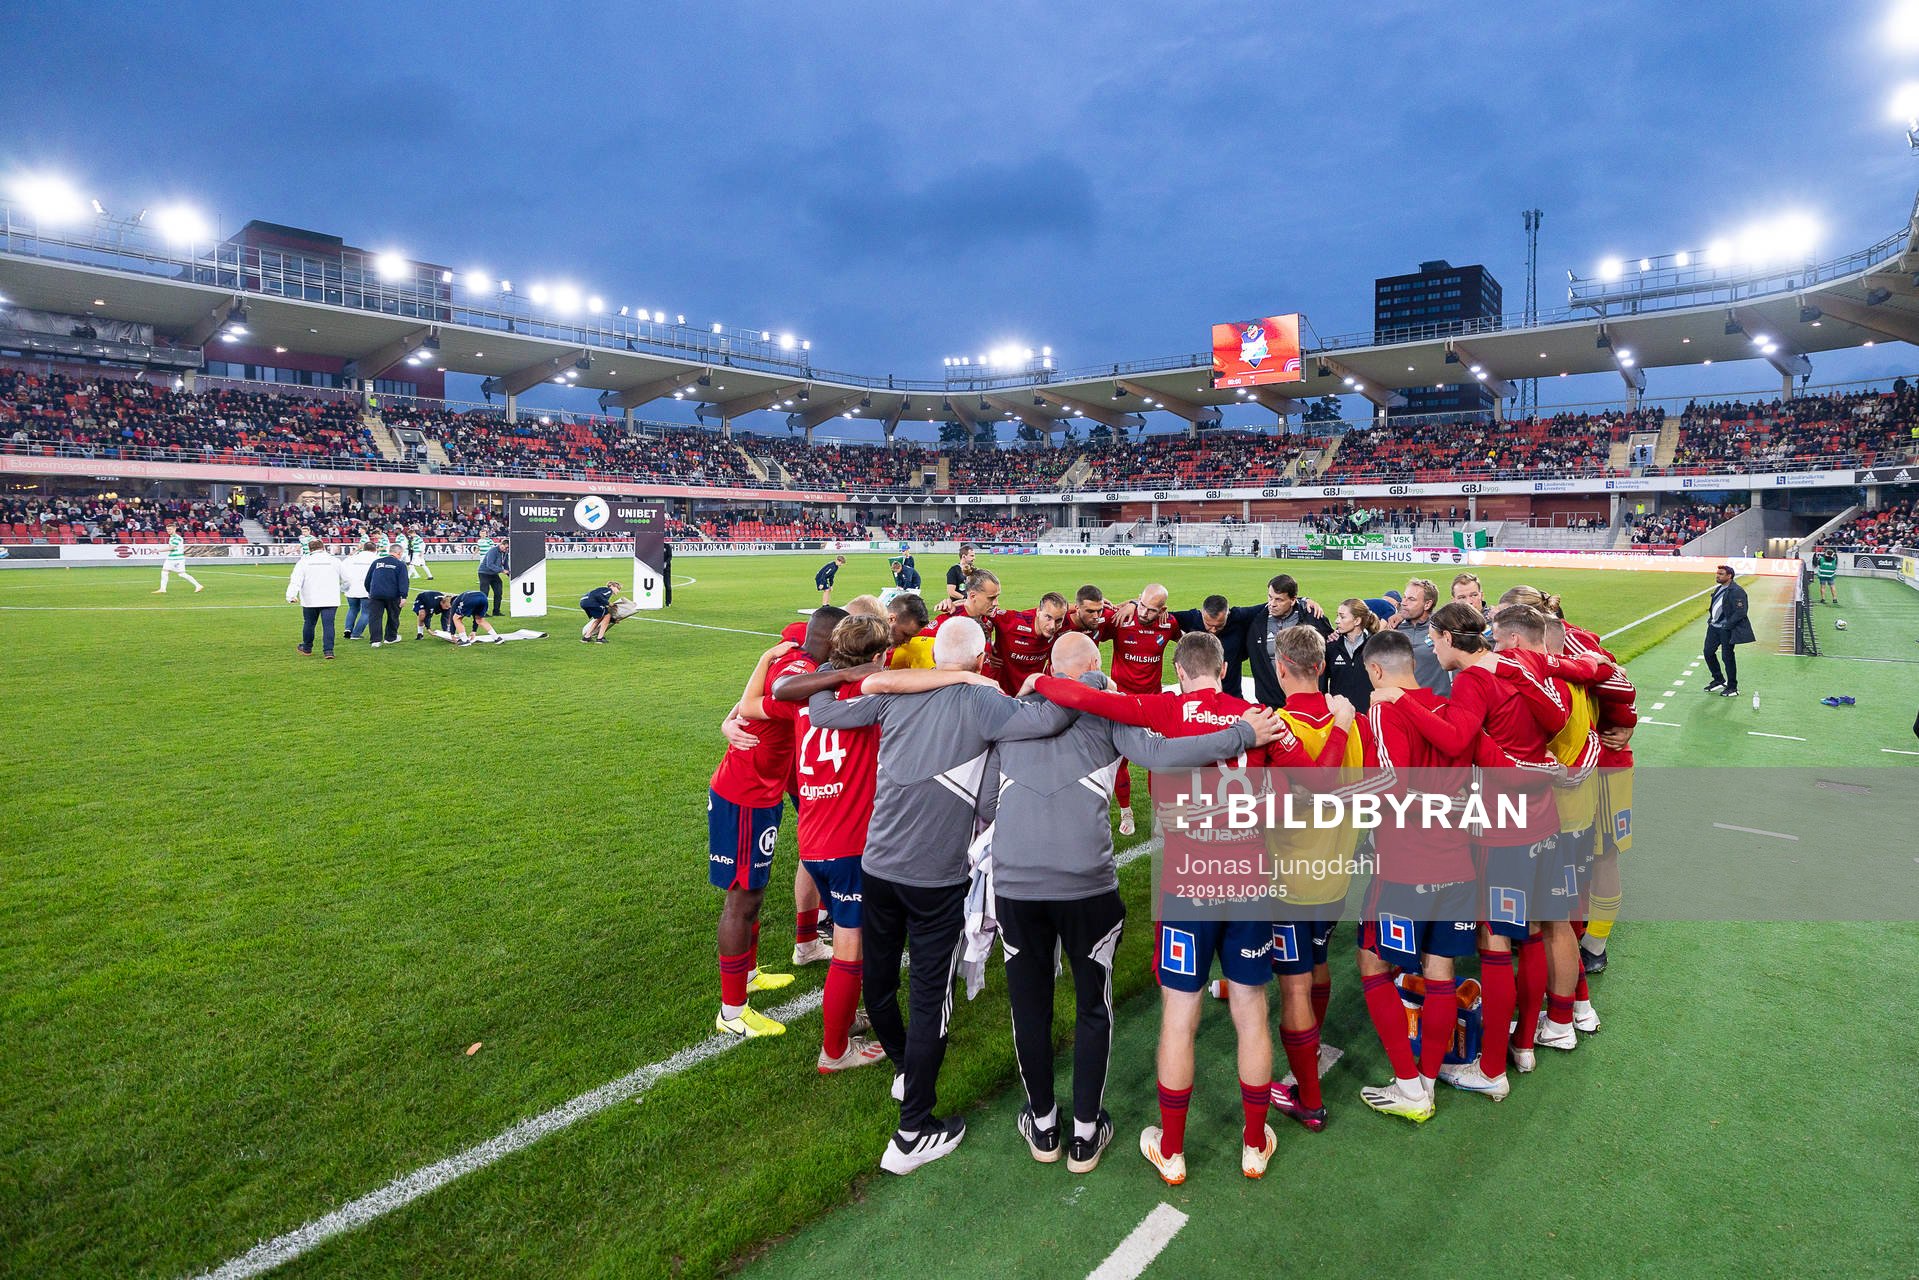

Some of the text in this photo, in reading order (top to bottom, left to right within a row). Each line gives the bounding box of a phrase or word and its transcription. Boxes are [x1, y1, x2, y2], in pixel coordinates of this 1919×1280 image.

[10, 459, 104, 472] Ekonomisystem
[1323, 487, 1341, 497] GBJ
[1389, 486, 1408, 495] GBJ
[1462, 484, 1482, 493] GBJ
[519, 506, 566, 517] UNIBET
[617, 508, 658, 519] UNIBET
[681, 544, 700, 552] DEN
[701, 543, 734, 552] LOKALA
[735, 543, 776, 551] IDROTTEN
[1100, 548, 1131, 556] Deloitte
[1353, 551, 1412, 562] EMILSHUS
[522, 582, 535, 596] U
[643, 578, 654, 591] U
[830, 890, 863, 902] SHAR
